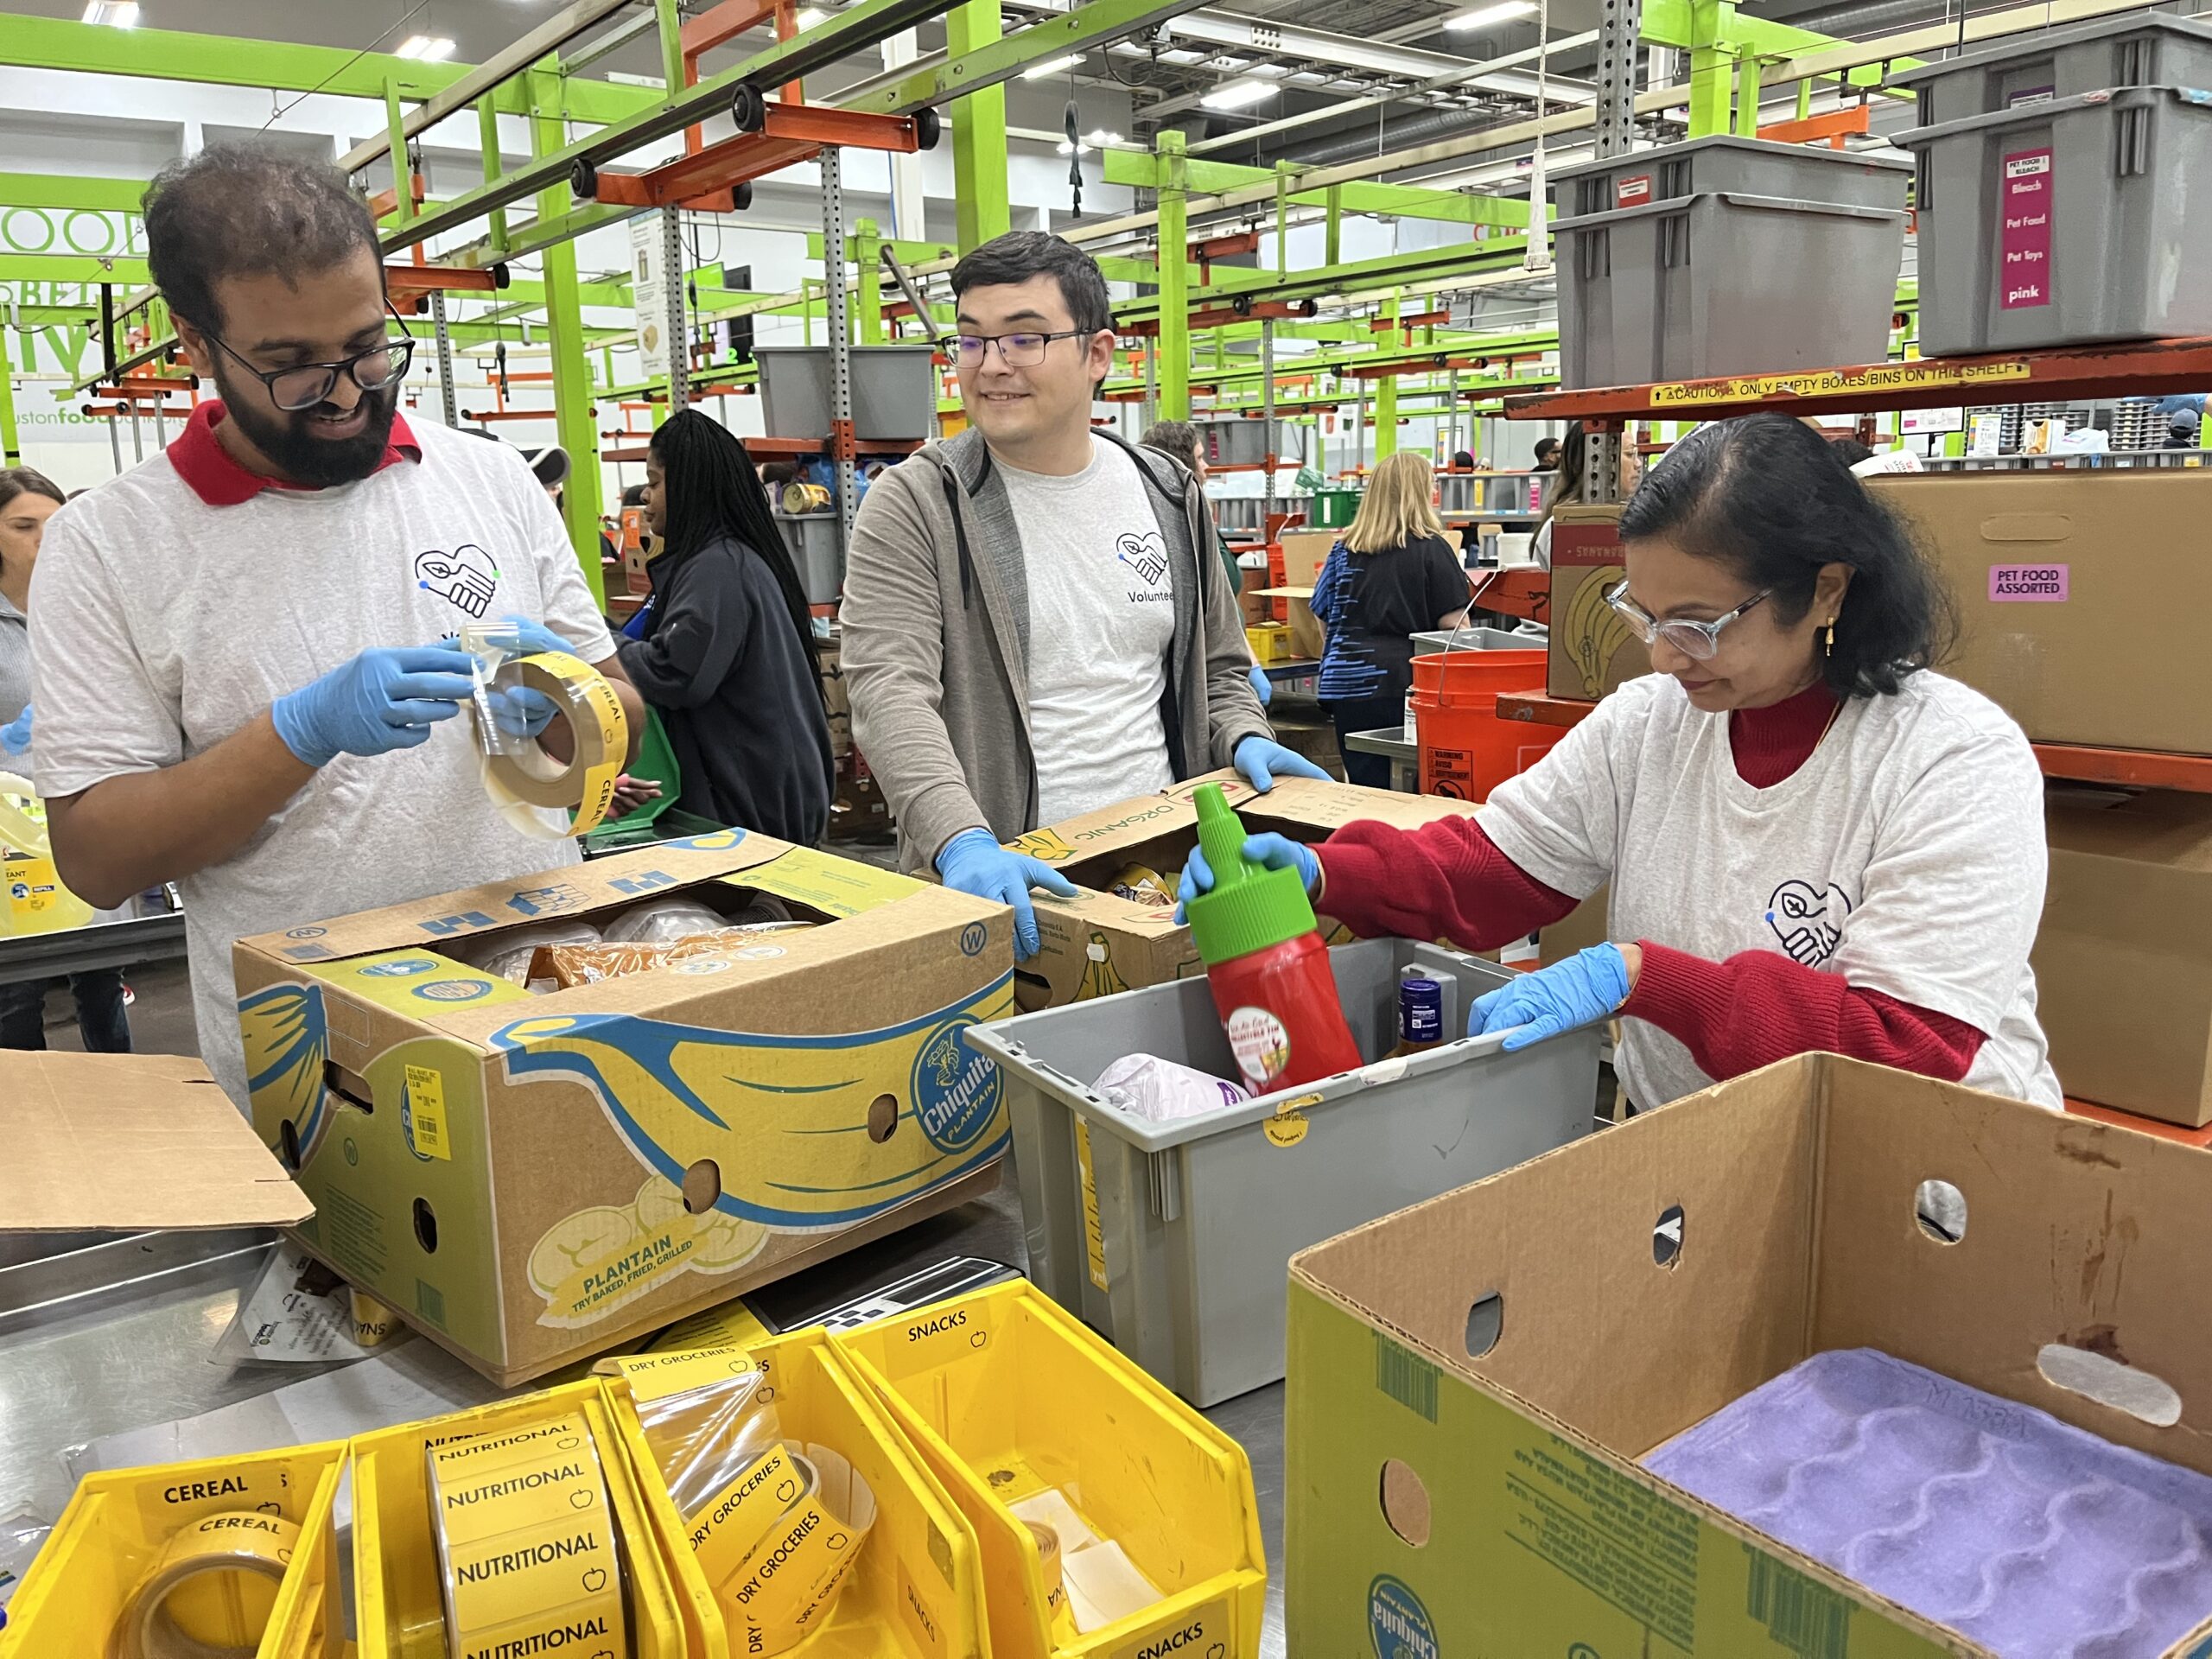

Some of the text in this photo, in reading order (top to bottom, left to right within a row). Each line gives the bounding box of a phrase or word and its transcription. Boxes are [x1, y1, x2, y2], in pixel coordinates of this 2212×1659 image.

[2008, 284, 2039, 303] pink
[1739, 382, 1772, 395] ONLY
[1821, 372, 1901, 389] BOXES/BINS
[1905, 370, 1925, 382] ON
[1995, 582, 2061, 594] ASSORTED
[1998, 569, 2059, 582] PET FOOD
[590, 779, 611, 822] CEREAL
[1074, 805, 1174, 841] ORGANIC
[923, 1053, 996, 1136] Chiquita
[947, 1081, 995, 1141] PLANTAIN
[572, 1240, 693, 1313] TRY BAKED, FRIED, GRILLED
[582, 1235, 672, 1294] PLANTAIN
[908, 1310, 967, 1342] SNACKS
[629, 1347, 736, 1372] DRY GROCERIES
[439, 1424, 572, 1461] NUTRITIONAL
[164, 1477, 248, 1503] CEREAL
[447, 1463, 585, 1509] NUTRITIONAL
[689, 1456, 781, 1552] DRY GROCERIES
[199, 1517, 282, 1535] CEREAL
[457, 1532, 599, 1586] NUTRITIONAL
[736, 1510, 820, 1605] DRY GROCERIES
[747, 1626, 763, 1654] DRY
[1137, 1622, 1204, 1659] SNACKS
